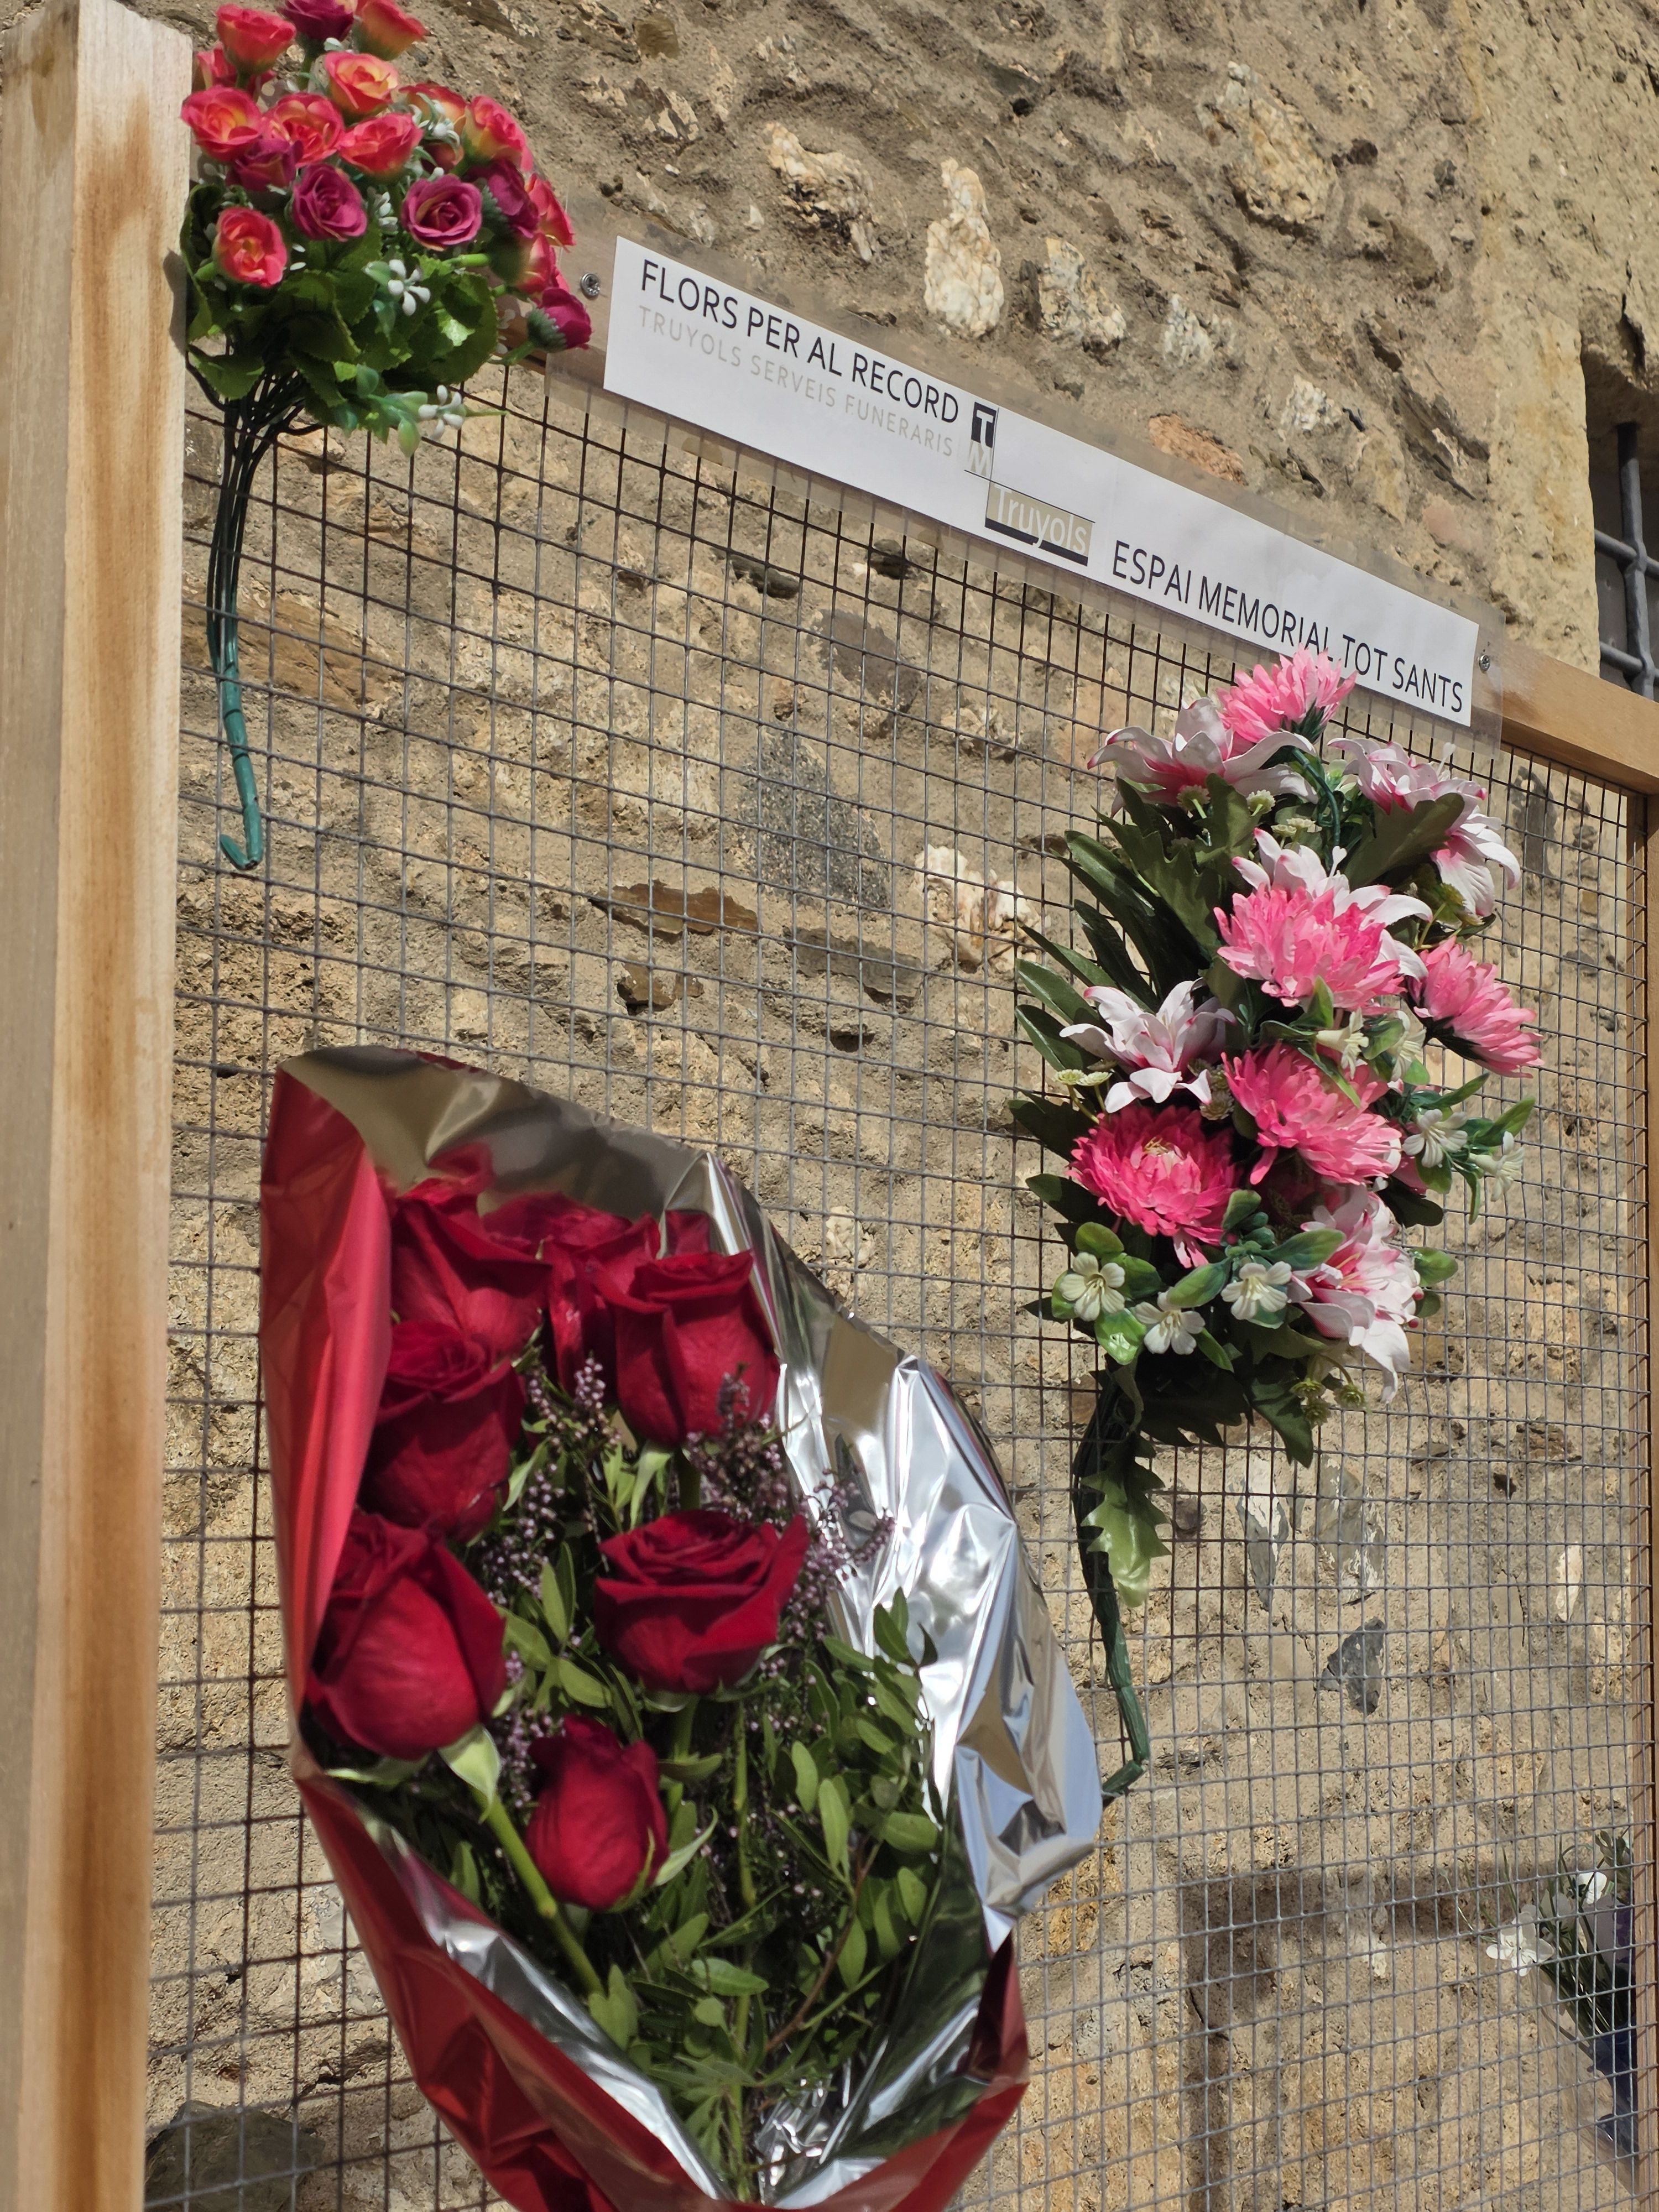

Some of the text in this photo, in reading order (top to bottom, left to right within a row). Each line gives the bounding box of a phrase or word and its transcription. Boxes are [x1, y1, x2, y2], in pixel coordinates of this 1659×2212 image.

[639, 305, 953, 457] TRUYOLS SERVEIS FUNERARIS
[641, 259, 958, 423] FLORS PER AL RECORD
[994, 484, 1086, 554] Truyols
[1112, 540, 1463, 713] ESPAI MEMORIAL TOT SANTS
